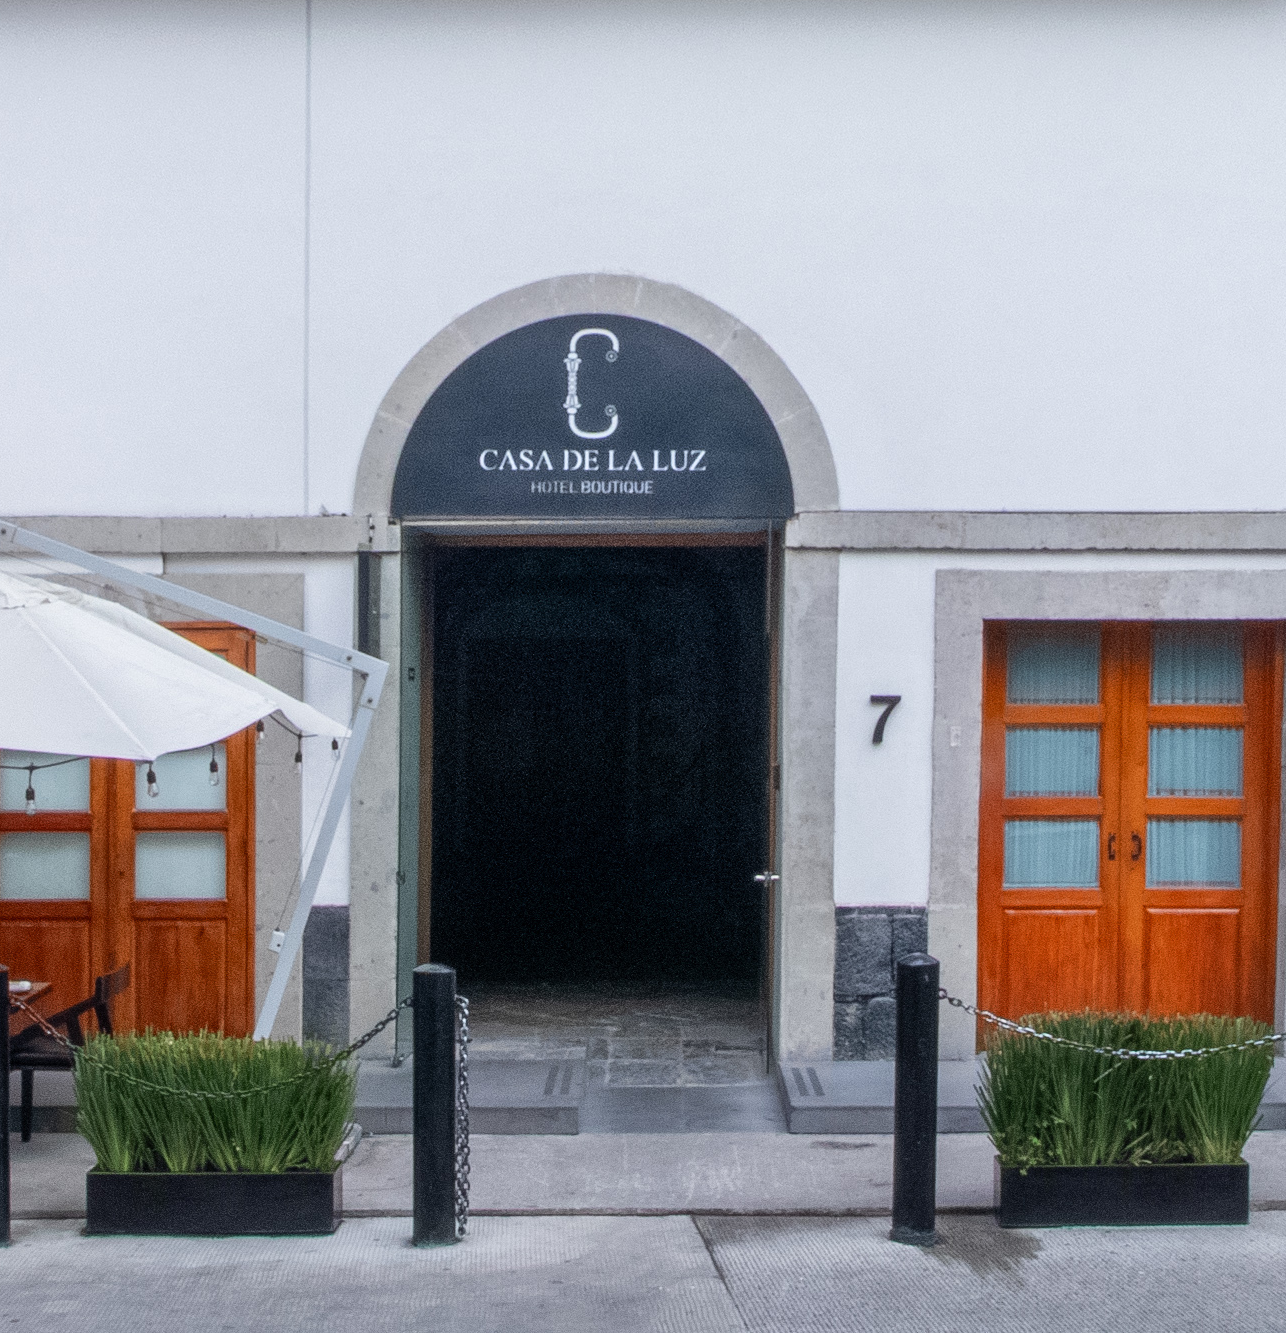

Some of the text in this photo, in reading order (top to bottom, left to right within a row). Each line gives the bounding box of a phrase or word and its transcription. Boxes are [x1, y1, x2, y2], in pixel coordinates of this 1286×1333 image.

[479, 449, 707, 471] CASA DE LA LUZ
[530, 480, 654, 494] HOTEL BOUTIQUE
[870, 694, 902, 745] 7
